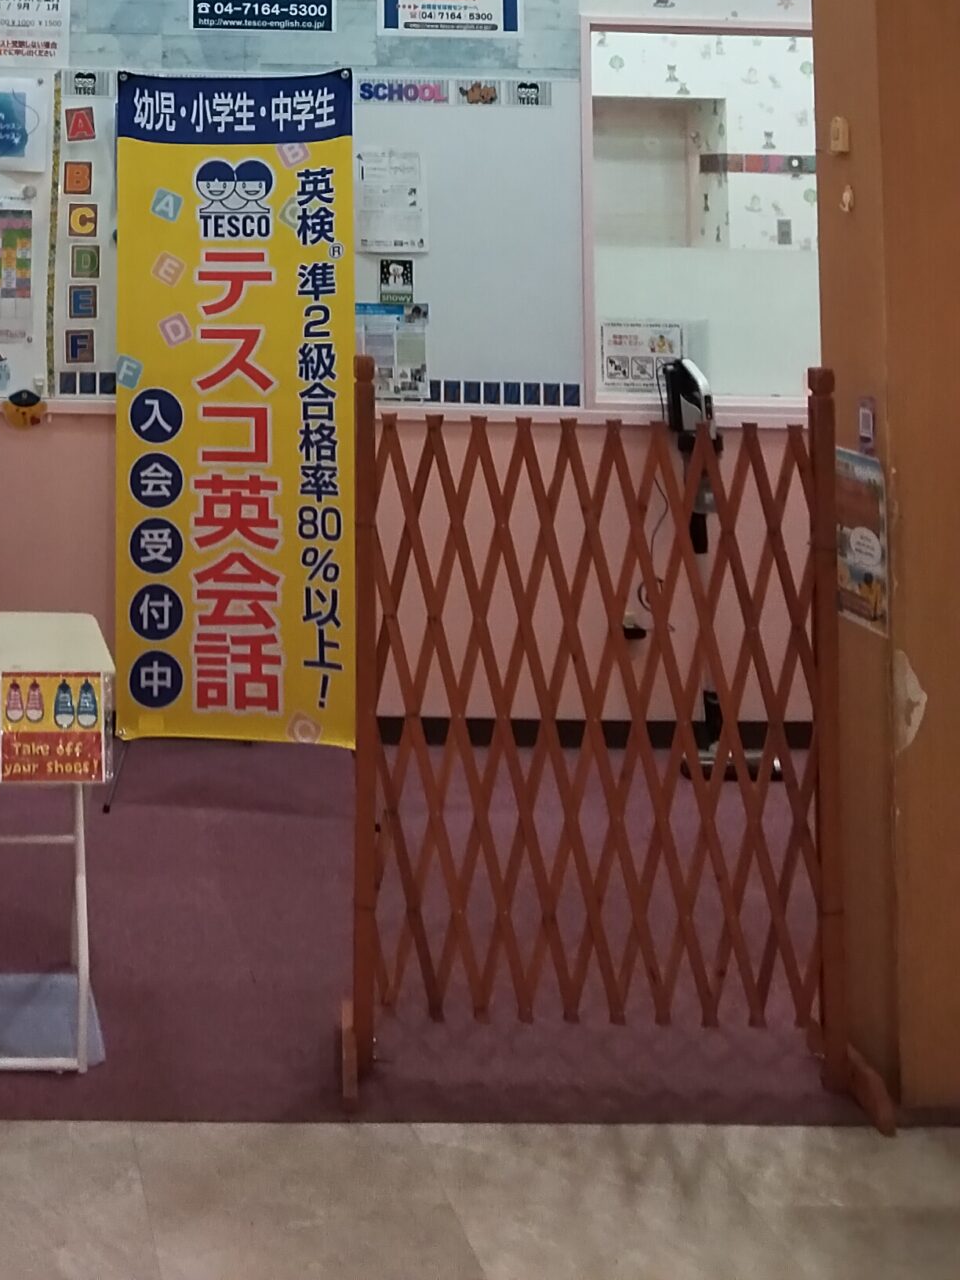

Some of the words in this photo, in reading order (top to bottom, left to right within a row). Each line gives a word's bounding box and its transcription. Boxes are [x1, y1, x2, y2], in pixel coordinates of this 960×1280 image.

[214, 2, 327, 17] 04-7164-5300
[359, 82, 449, 103] SCHOOL
[519, 97, 539, 106] TESCO
[133, 86, 337, 132] 幼児・小学生・中学生
[66, 109, 96, 138] A
[65, 162, 91, 193] B
[70, 205, 97, 234] C
[199, 214, 272, 238] TESCO
[72, 246, 100, 276] D
[70, 288, 95, 315] E
[381, 293, 412, 304] snowy
[68, 333, 91, 361] F
[193, 251, 282, 712] テスコ英会話
[138, 398, 173, 697] 入会受付中
[12, 741, 50, 756] Take
[56, 740, 84, 756] off
[4, 762, 39, 776] your
